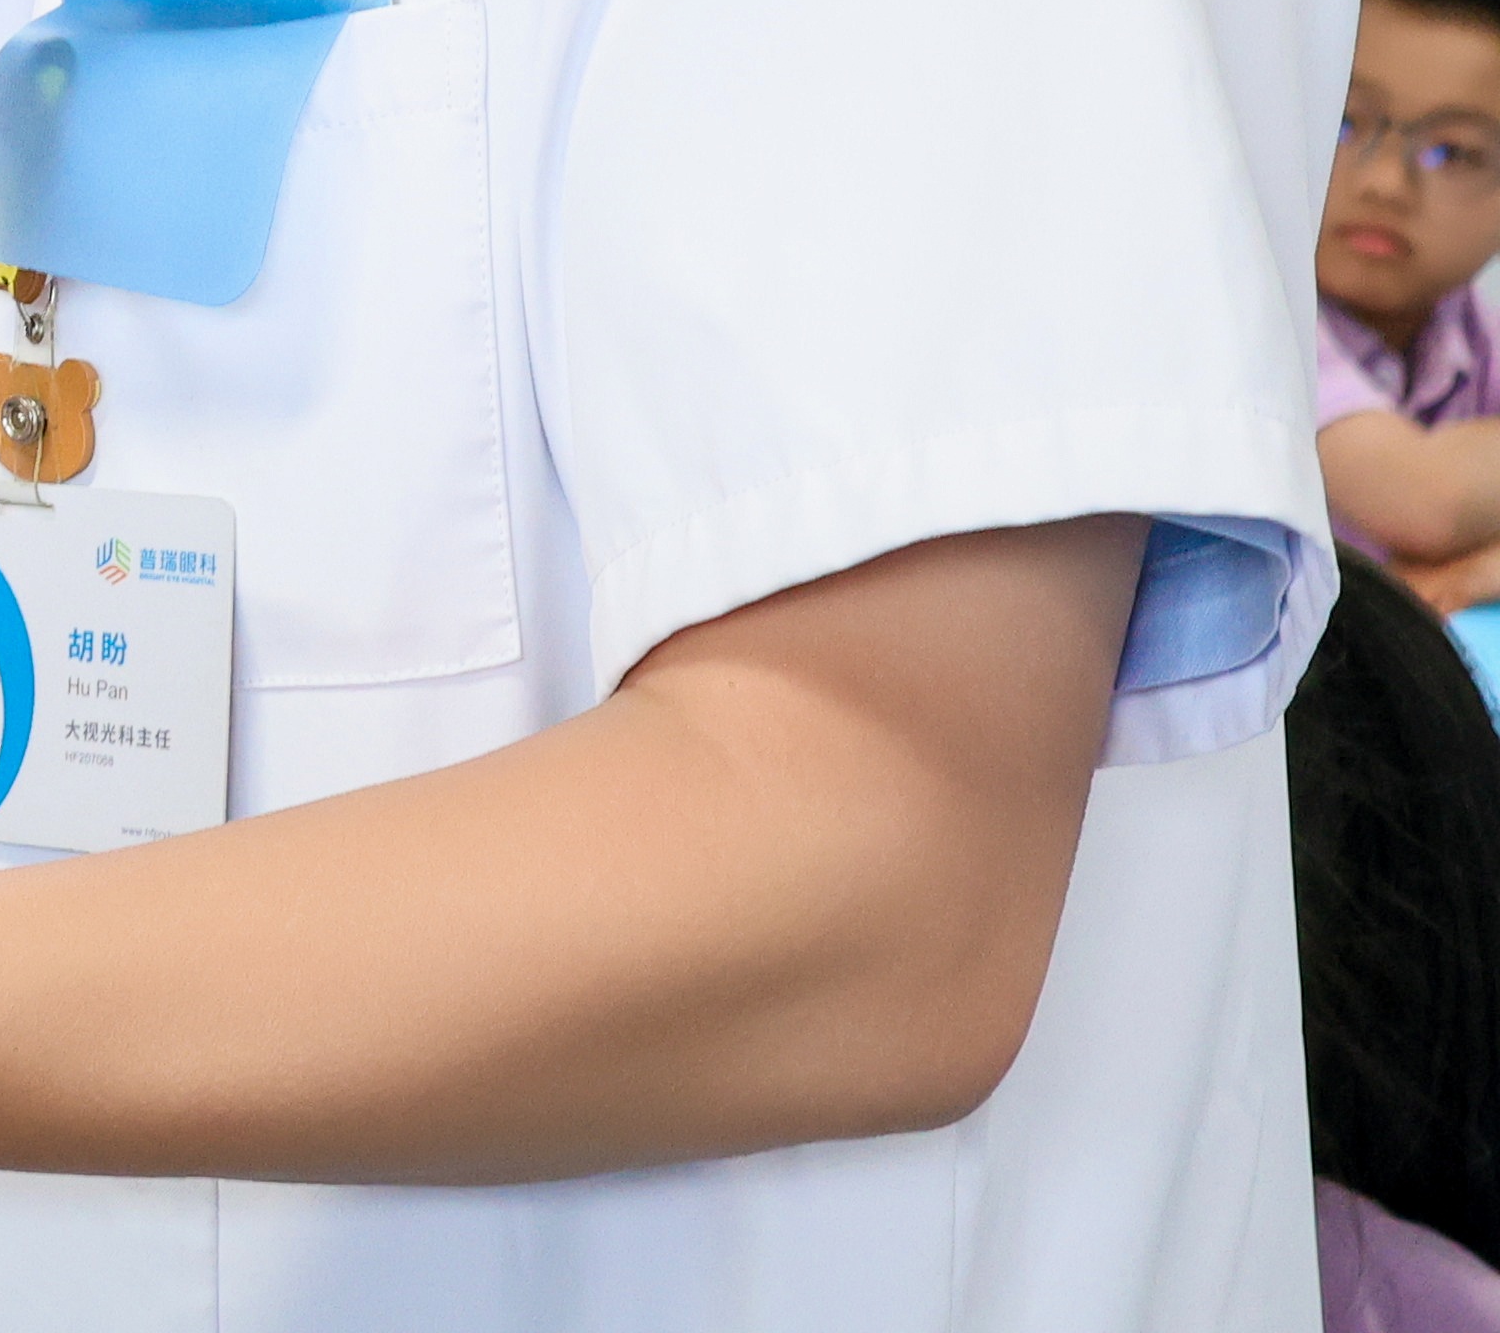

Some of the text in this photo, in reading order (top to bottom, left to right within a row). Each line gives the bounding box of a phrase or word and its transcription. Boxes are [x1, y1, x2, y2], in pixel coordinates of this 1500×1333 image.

[140, 548, 217, 575] 普瑞眼科
[68, 627, 128, 666] 胡盼
[67, 676, 129, 701] Hu Pan
[64, 718, 172, 751] 大视光科主任
